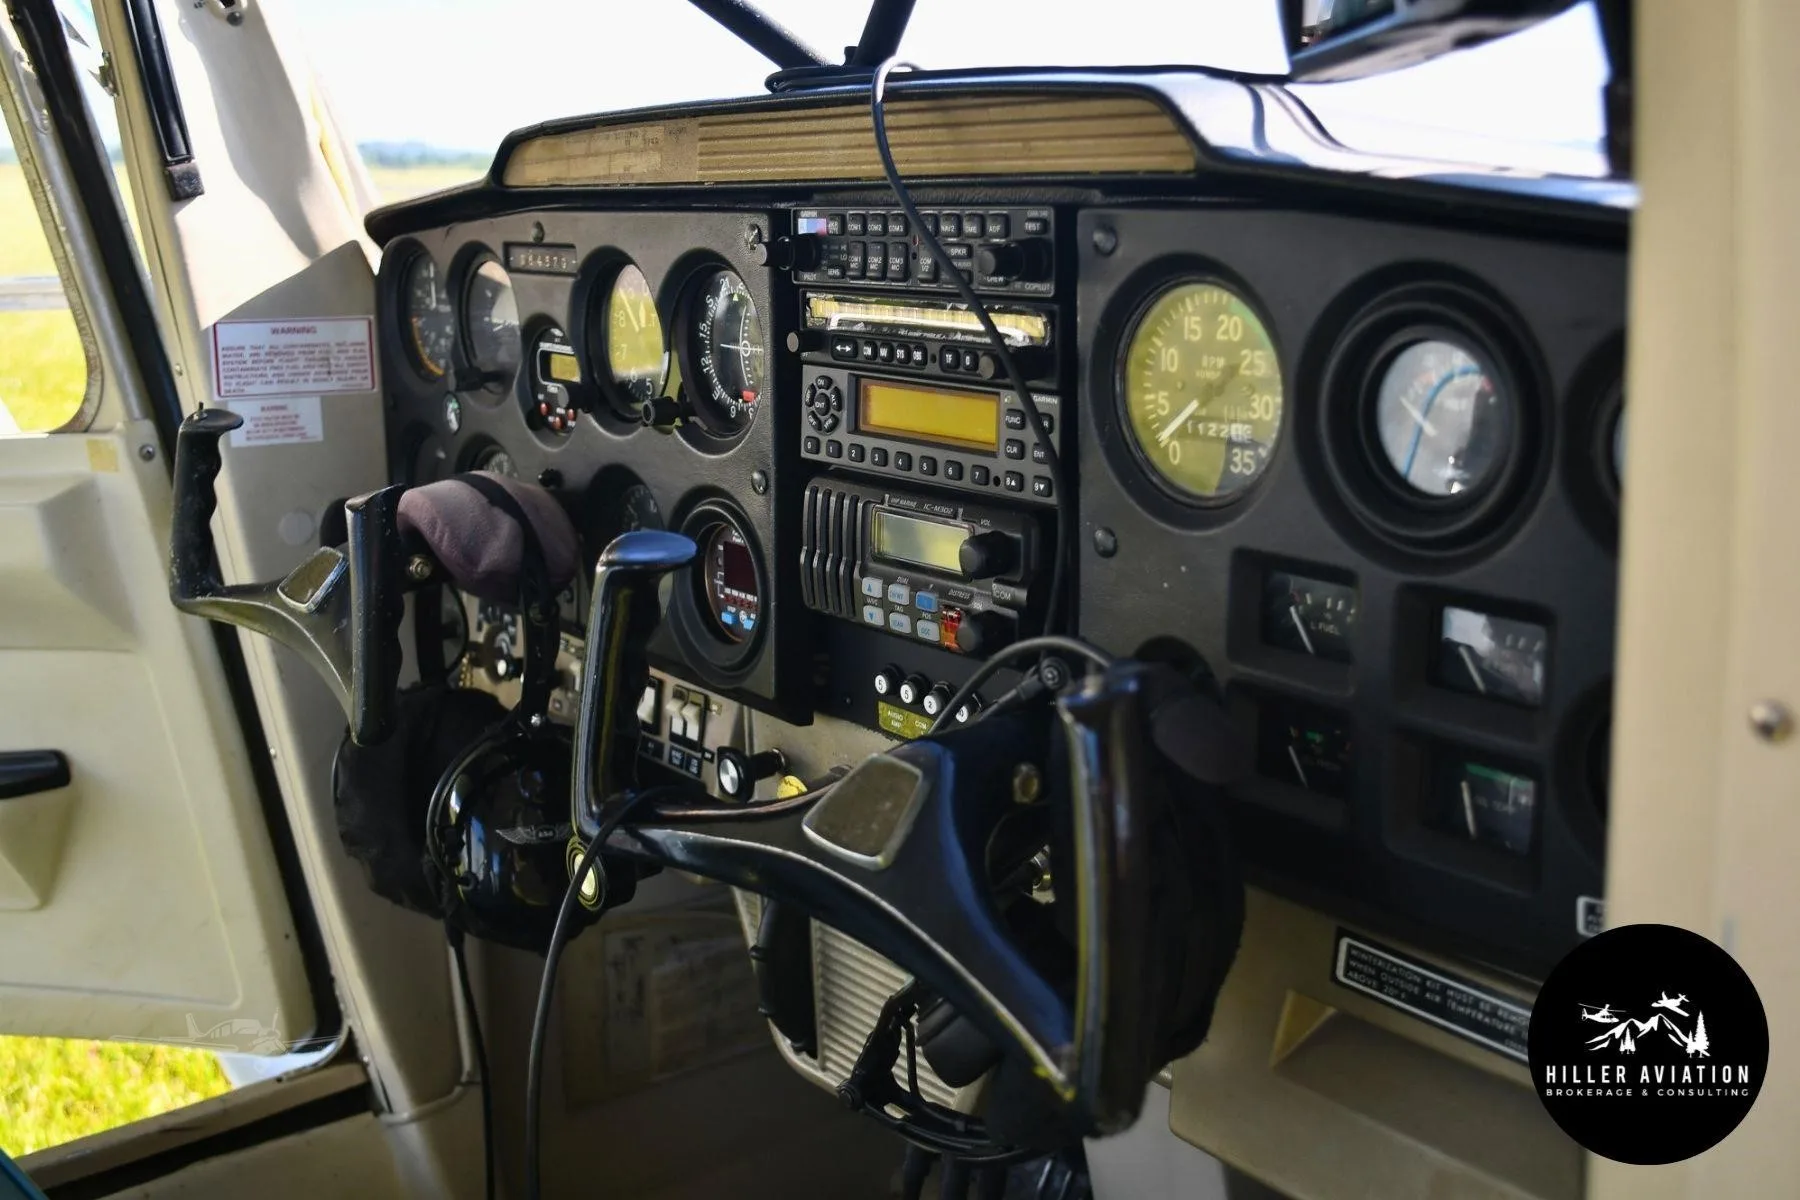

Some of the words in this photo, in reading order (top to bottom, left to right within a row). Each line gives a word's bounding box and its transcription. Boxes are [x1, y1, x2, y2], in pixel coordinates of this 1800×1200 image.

[1024, 222, 1041, 231] TEST
[271, 326, 317, 335] WARNING
[1184, 316, 1202, 341] 15
[1216, 314, 1242, 341] 20
[1161, 348, 1178, 373] 10
[1202, 355, 1225, 368] RPM
[1239, 349, 1265, 377] 25
[1157, 391, 1169, 416] 5
[1250, 394, 1274, 421] 30
[1005, 415, 1021, 425] FUNC
[1006, 446, 1018, 454] CLR
[1168, 441, 1180, 465] 0
[1230, 448, 1255, 475] 35
[1346, 969, 1378, 989] ABOVE
[1349, 948, 1421, 982] WINTERIZATION
[1425, 980, 1441, 991] KIT
[1446, 987, 1474, 1004] MUST
[1349, 960, 1376, 976] WHEN
[1380, 972, 1420, 995] OUTSIDE
[1424, 992, 1442, 1004] AIR
[1446, 998, 1516, 1036] TEMPERATURE
